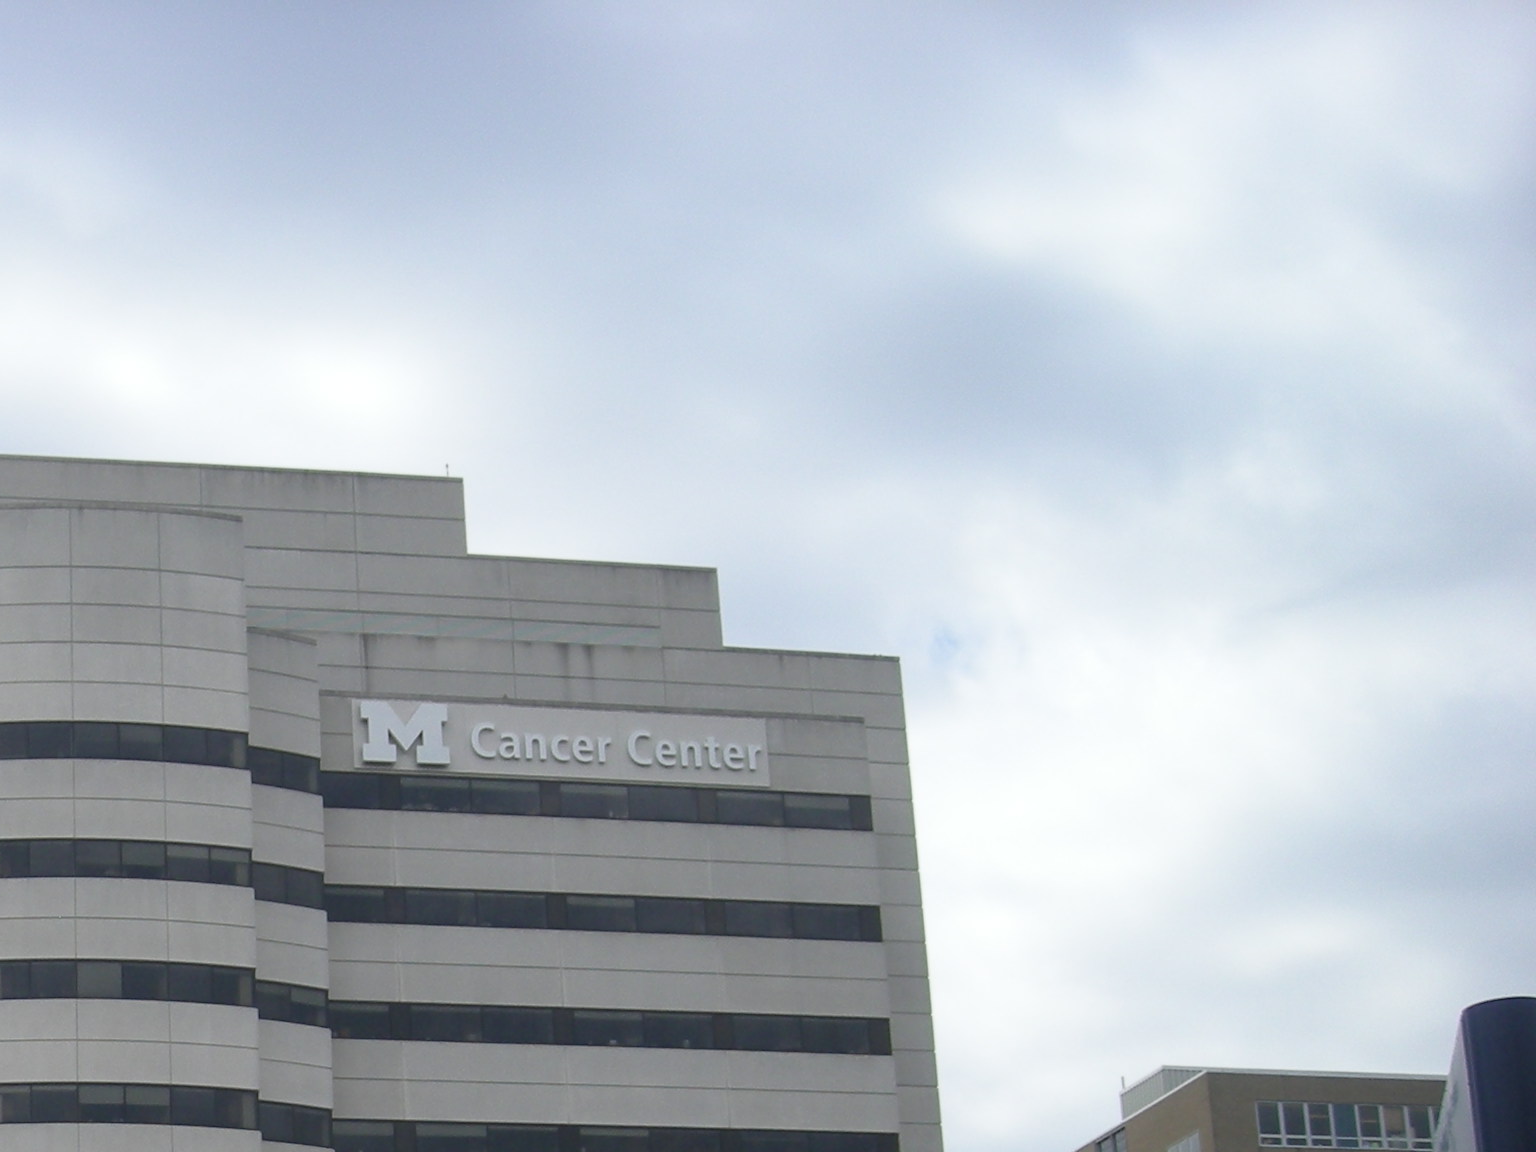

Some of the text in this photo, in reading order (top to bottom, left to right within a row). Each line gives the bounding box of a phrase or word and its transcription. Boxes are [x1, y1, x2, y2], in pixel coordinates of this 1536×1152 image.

[360, 702, 761, 771] M Cancer Center
